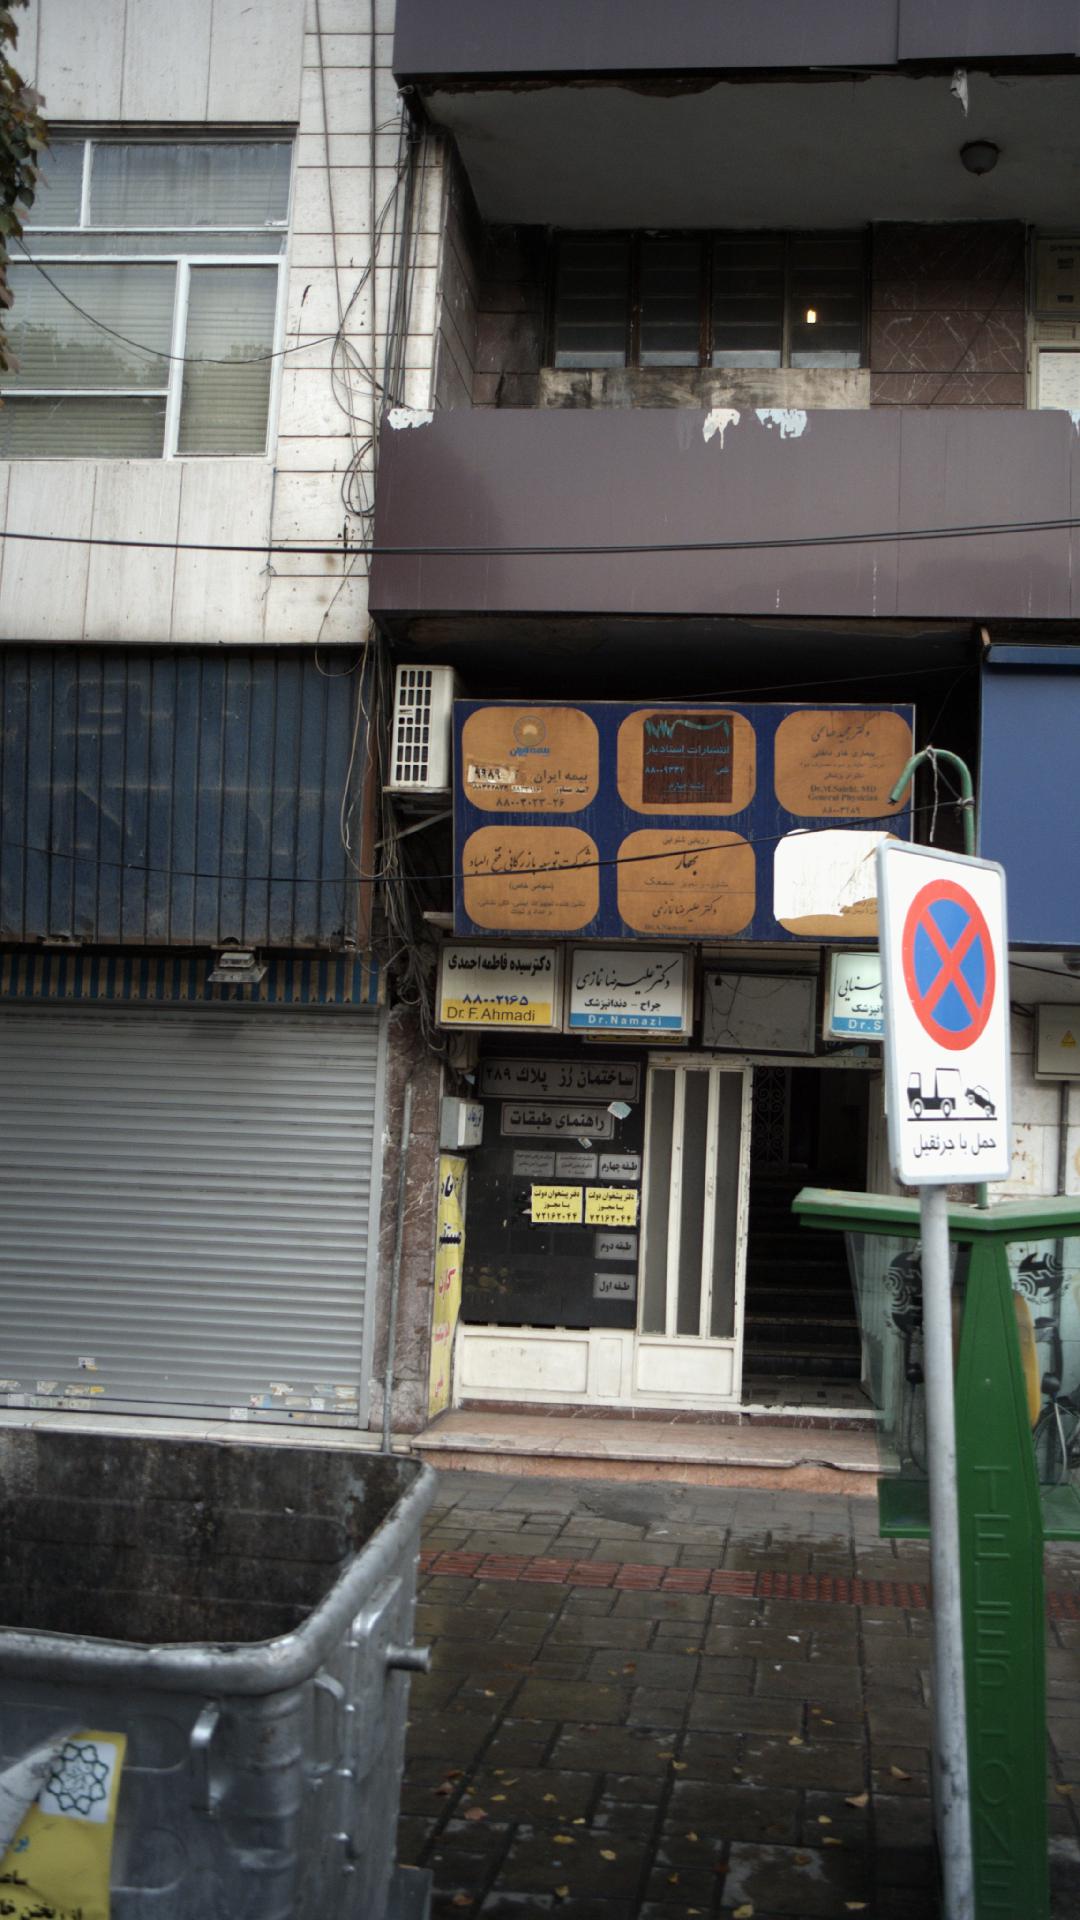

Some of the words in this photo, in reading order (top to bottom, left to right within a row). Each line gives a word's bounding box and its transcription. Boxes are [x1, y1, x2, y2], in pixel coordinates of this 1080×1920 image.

[533, 769, 561, 785] ایران
[564, 772, 588, 784] بیمه
[448, 954, 481, 971] احمدی
[482, 953, 508, 971] فاطمه
[530, 955, 552, 977] دکتر
[645, 959, 680, 994] دکتر
[463, 994, 529, 1006] ۸۸۰۰۲۱۶۵
[640, 1000, 661, 1011] جراح
[481, 1008, 536, 1022] Ahmadi
[577, 1068, 634, 1089] ساختمان
[510, 1110, 552, 1130] طبقات
[555, 1112, 605, 1131] راهنمای
[959, 1132, 968, 1156] با
[971, 1132, 997, 1156] حمل
